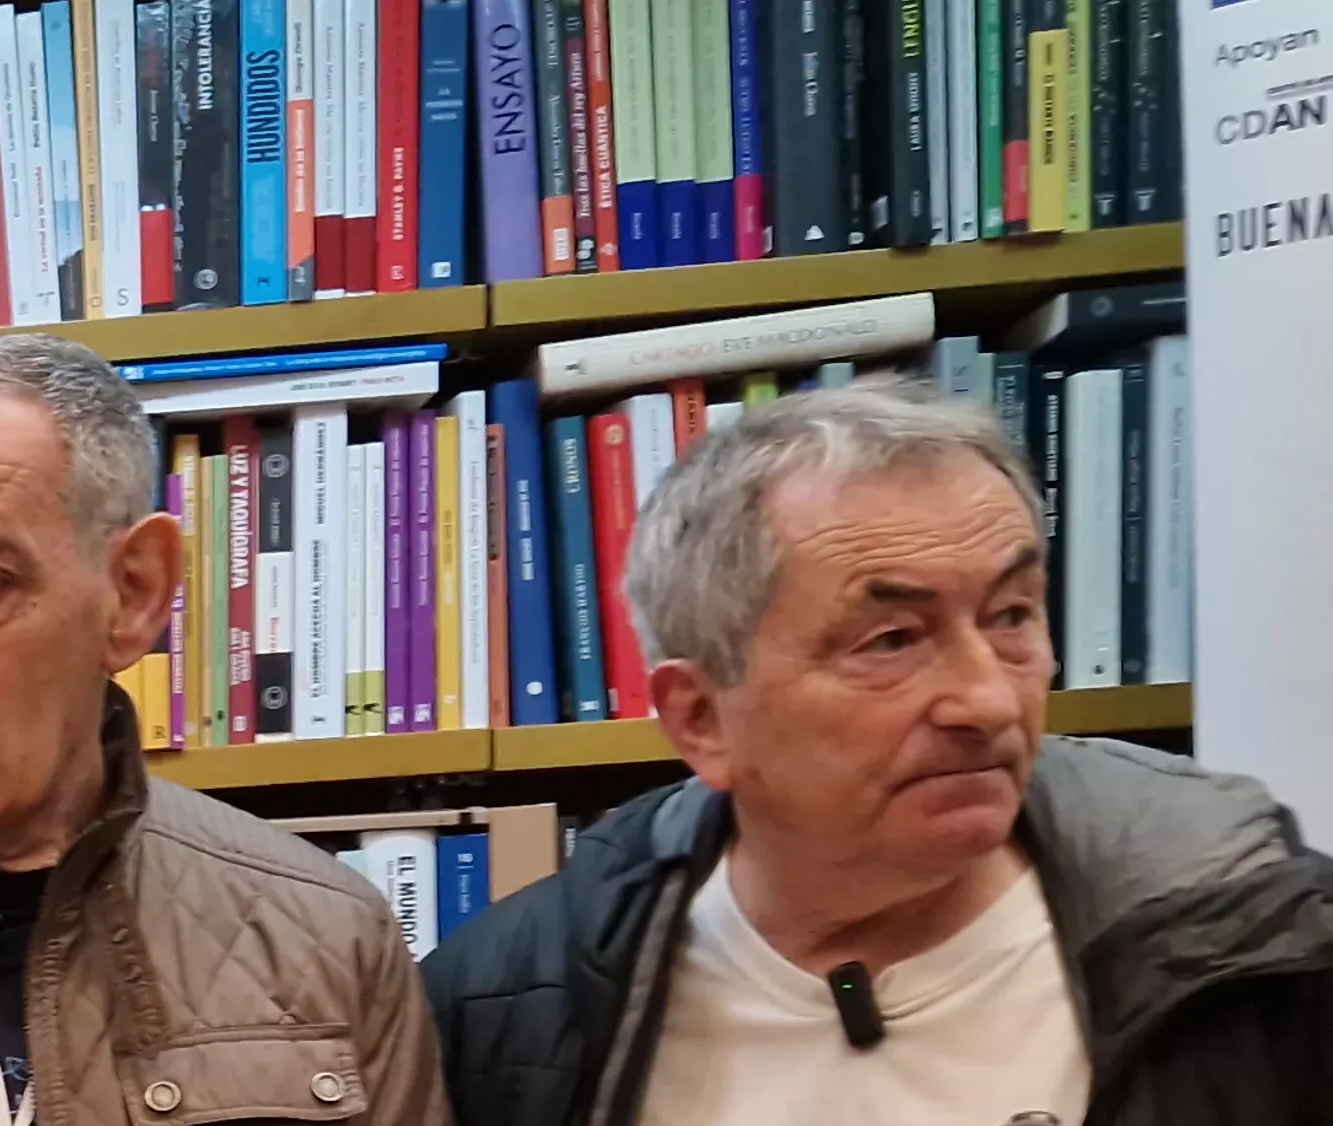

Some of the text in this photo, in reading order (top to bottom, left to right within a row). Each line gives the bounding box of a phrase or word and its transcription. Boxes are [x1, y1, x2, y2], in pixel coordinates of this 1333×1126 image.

[490, 23, 526, 156] ENSAYO
[1215, 28, 1319, 66] Apoyan
[245, 49, 281, 164] HUNDIDOS
[1215, 95, 1328, 146] CDAN
[397, 855, 420, 944] EL MUNDO
